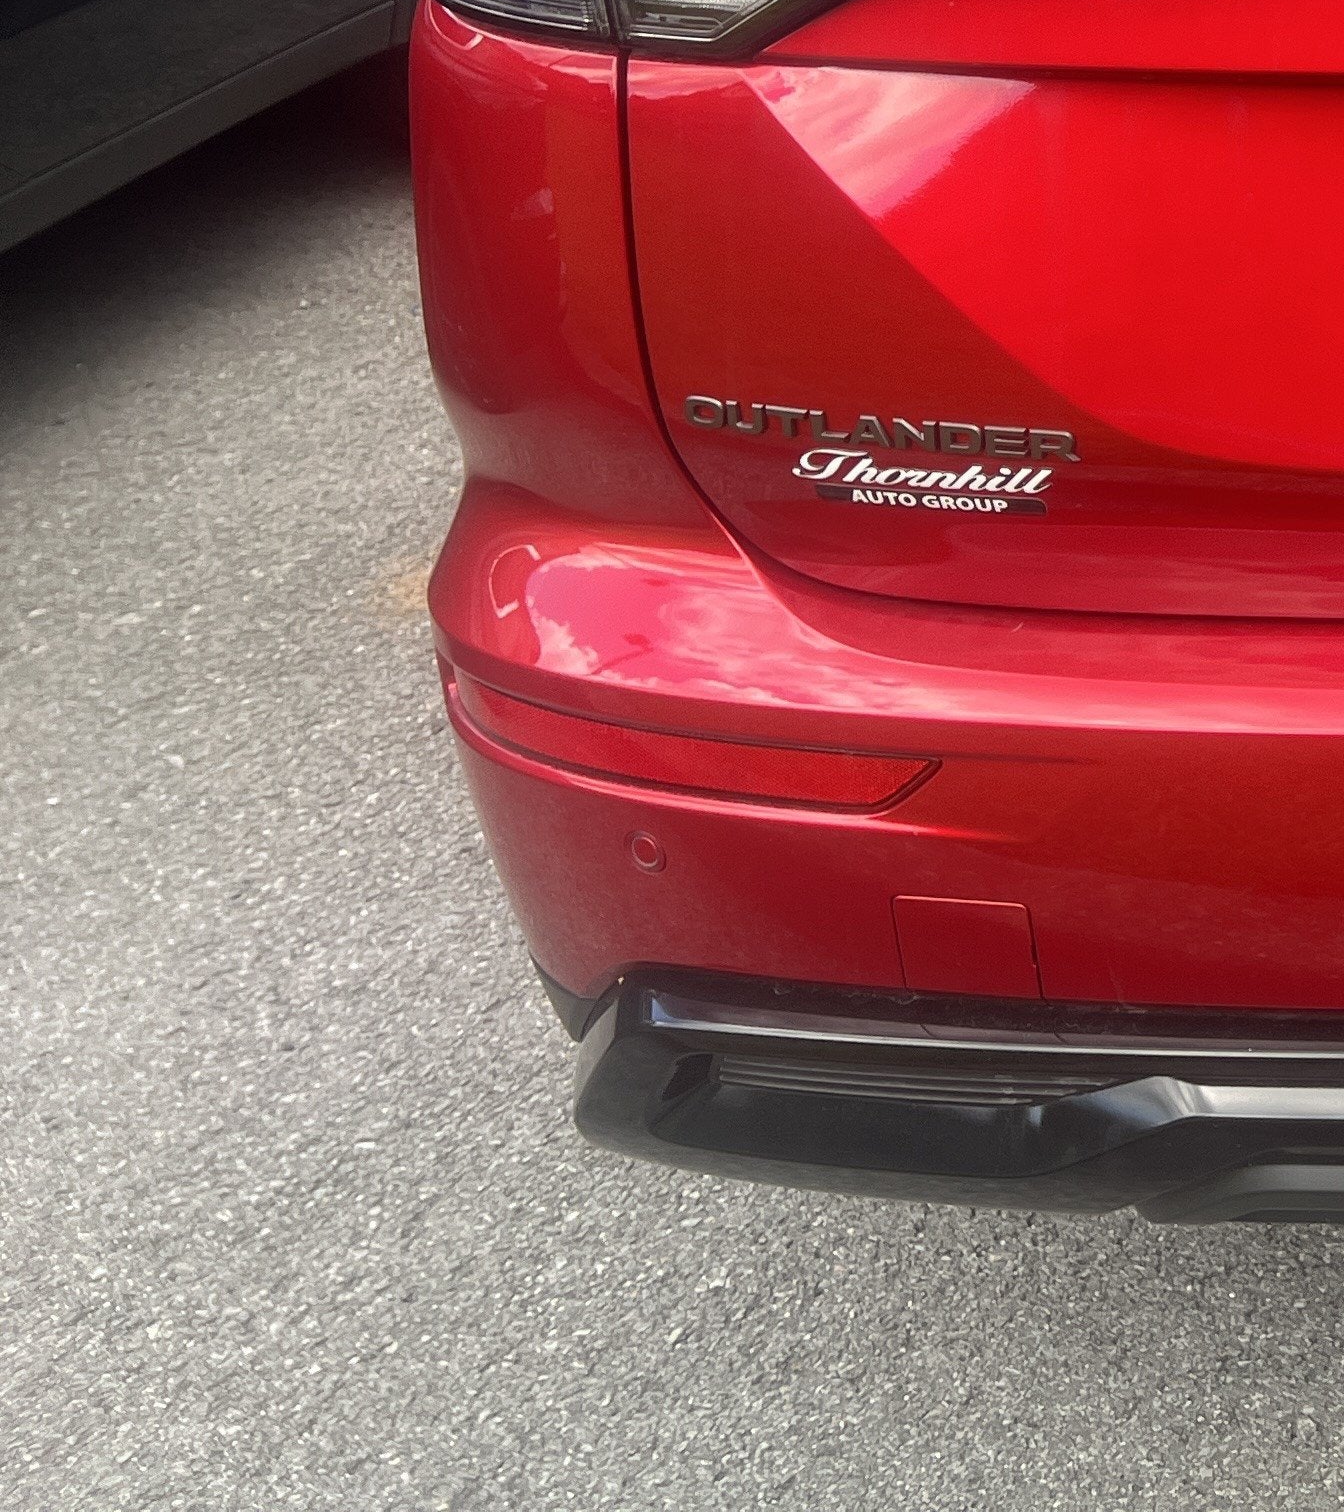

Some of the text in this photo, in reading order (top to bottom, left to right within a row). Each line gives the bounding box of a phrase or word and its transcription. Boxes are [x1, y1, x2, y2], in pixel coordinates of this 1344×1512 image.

[684, 394, 1082, 463] OUTLANDER
[791, 447, 1054, 495] Thornhill
[852, 487, 1009, 514] AUTO GROUP
